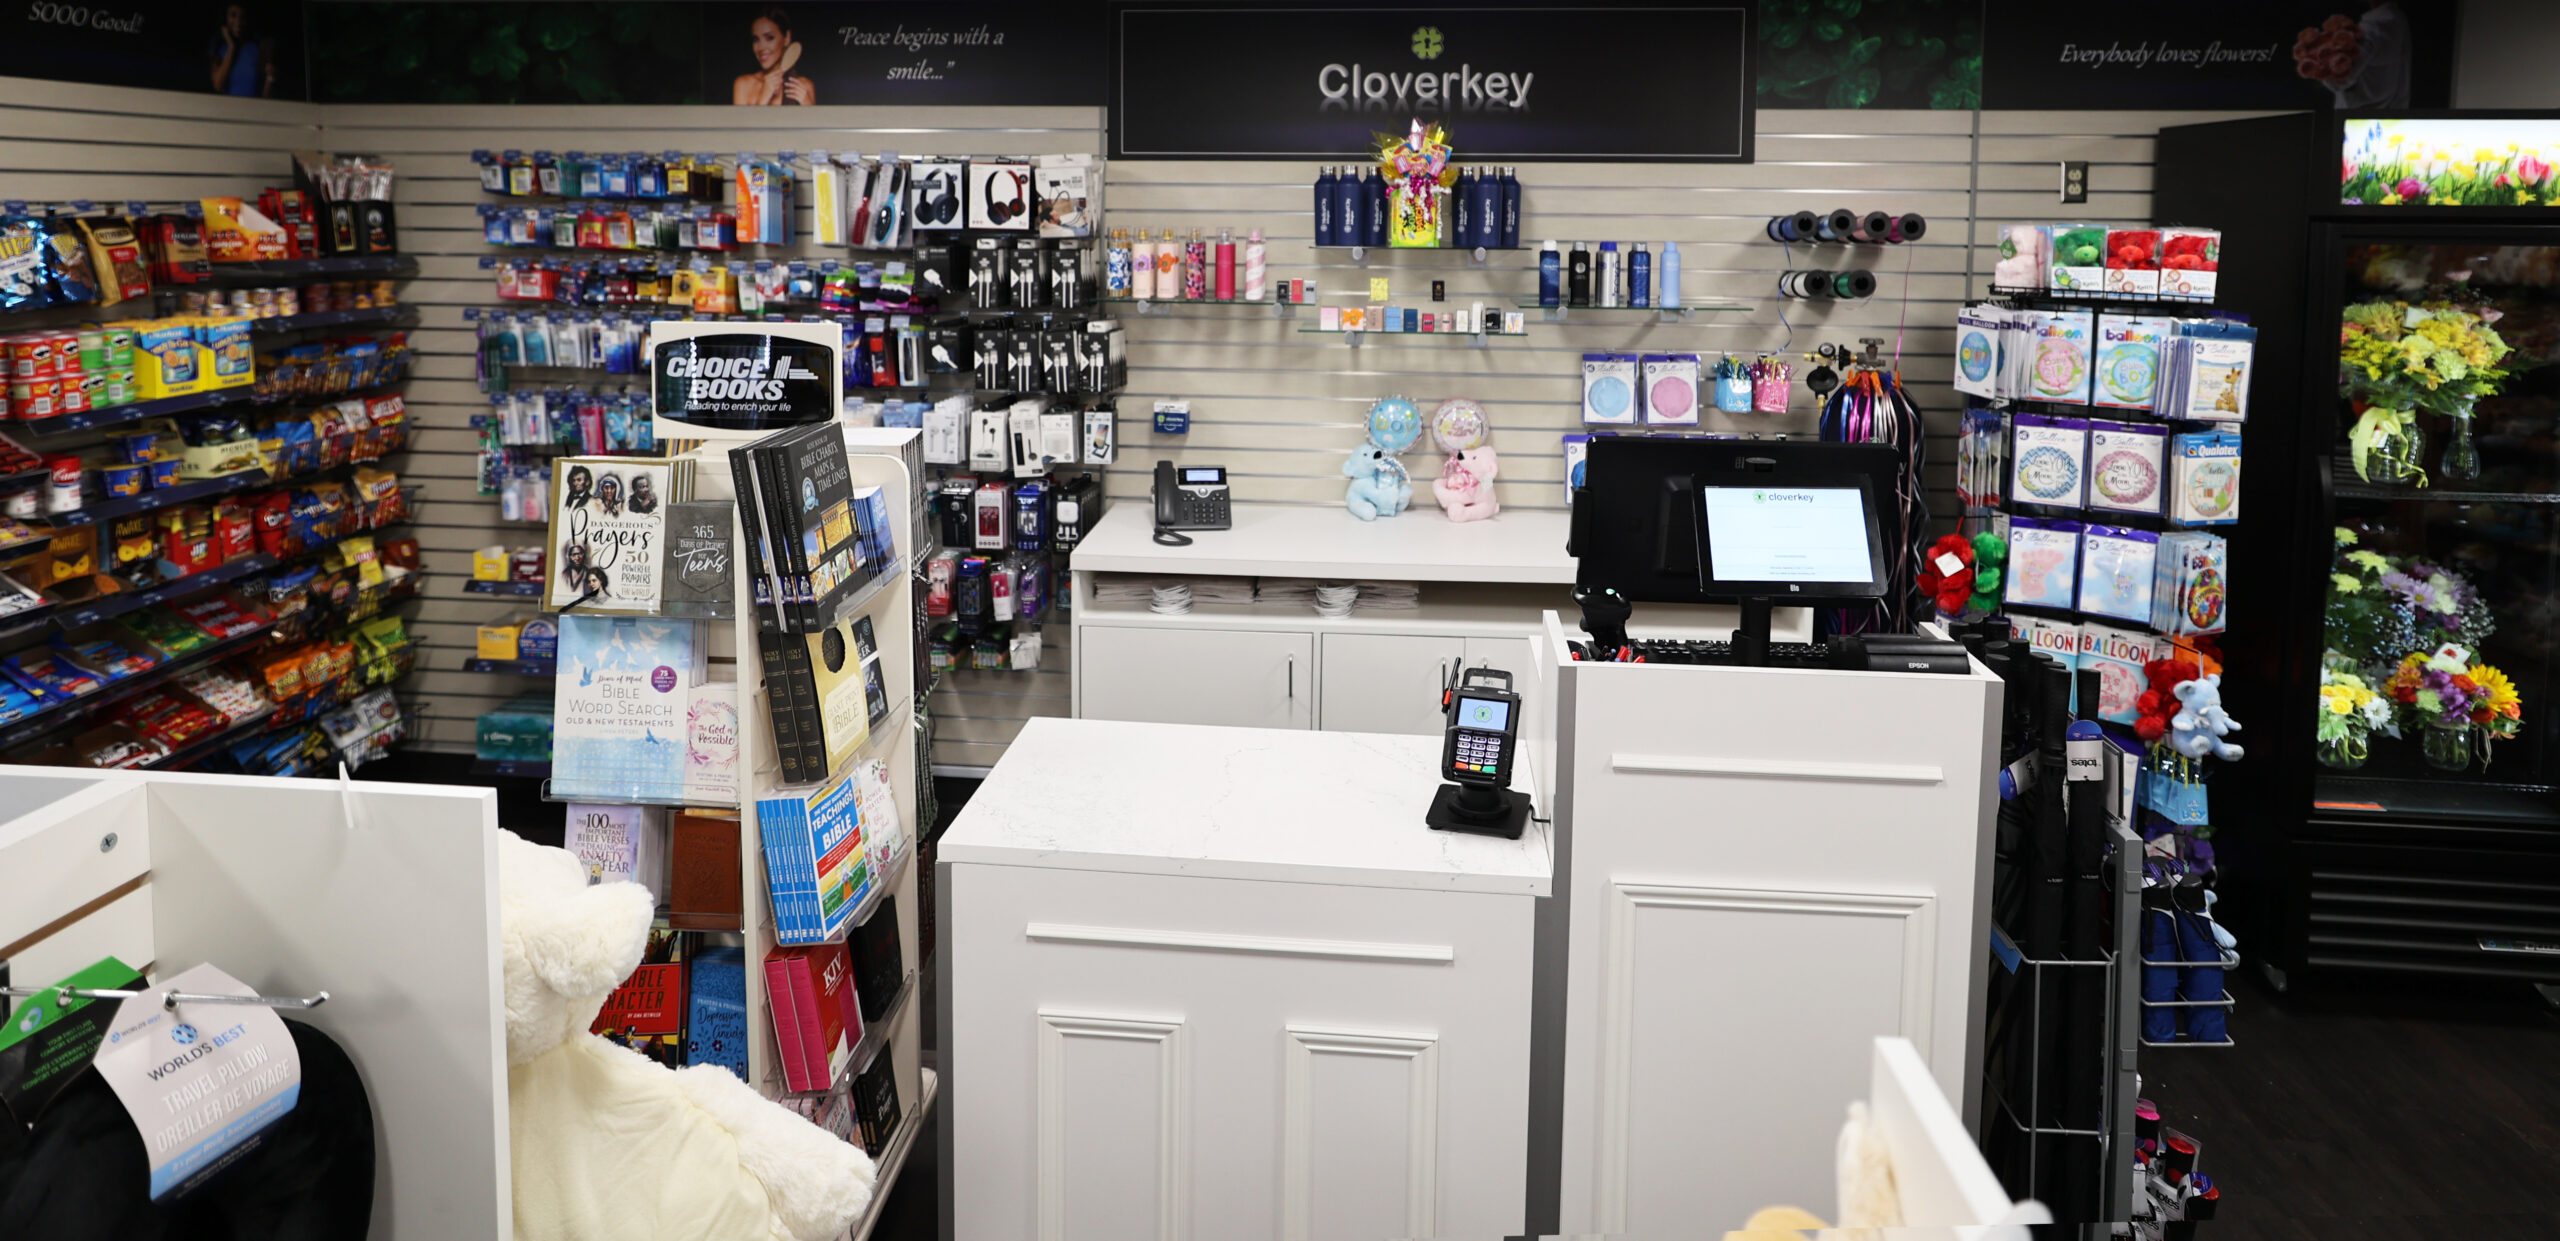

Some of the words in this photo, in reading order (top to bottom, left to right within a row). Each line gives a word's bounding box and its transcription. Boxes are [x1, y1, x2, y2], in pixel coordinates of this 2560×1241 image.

[28, 1, 90, 27] SOOO
[91, 7, 145, 34] Good!
[894, 24, 949, 51] begins
[953, 25, 989, 45] with
[993, 32, 1004, 45] a
[2060, 42, 2152, 68] Everybody
[2156, 42, 2201, 64] loves
[2202, 42, 2278, 67] flowers!
[1318, 63, 1534, 107] Cloverkey
[1972, 320, 1996, 329] BALLOON
[2037, 326, 2083, 339] alloon
[667, 357, 767, 379] CHOICE
[688, 379, 785, 401] BOOKS
[684, 401, 720, 412] Reading
[721, 402, 730, 411] to
[731, 403, 757, 411] enrich
[758, 404, 777, 413] your
[778, 402, 791, 412] life
[2198, 445, 2238, 457] Qualatex
[800, 452, 816, 470] BIBLE
[814, 464, 829, 478] MAPS
[829, 461, 836, 472] &
[817, 477, 832, 493] TIME
[832, 466, 848, 486] LINES
[1768, 492, 1814, 503] cloverkey
[116, 518, 145, 537] AWAKE
[590, 521, 653, 529] DANGEROUS
[692, 525, 714, 538] 365
[51, 534, 82, 550] AWAKE
[570, 508, 654, 569] Prayers
[705, 541, 726, 550] Prayer
[625, 552, 649, 563] 50
[674, 548, 728, 579] Teens
[621, 573, 651, 584] PRAYERS
[2011, 627, 2074, 652] BALLOON
[2084, 635, 2150, 664] BALLOON
[602, 684, 640, 700] BIBLE
[569, 700, 613, 715] WORD
[618, 701, 672, 716] SEARCH
[566, 717, 582, 725] OLD
[595, 718, 614, 726] NEW
[618, 719, 674, 728] TESTAMENTS
[834, 704, 859, 731] BIBLE
[709, 724, 726, 735] God
[698, 733, 734, 745] Possible
[2070, 758, 2097, 767] totes
[812, 790, 853, 832] TEACHINGS
[587, 813, 609, 829] 100
[577, 833, 598, 842] BIBLE
[601, 836, 630, 845] VERSES
[586, 828, 625, 836] IMPORTANT
[822, 814, 852, 851] BIBLE
[579, 850, 624, 863] ANXIETY
[602, 861, 630, 873] FEAR
[823, 953, 843, 989] KJV
[698, 1007, 743, 1025] Depression
[147, 1042, 213, 1082] WORLD'S
[212, 1024, 247, 1048] BEST
[162, 1072, 218, 1114] TRAVEL
[219, 1043, 270, 1089] PILLOW
[155, 1099, 224, 1153] OREILLER
[225, 1091, 242, 1116] DE
[242, 1058, 291, 1099] VOYAGE
[2156, 1189, 2180, 1210] totes
